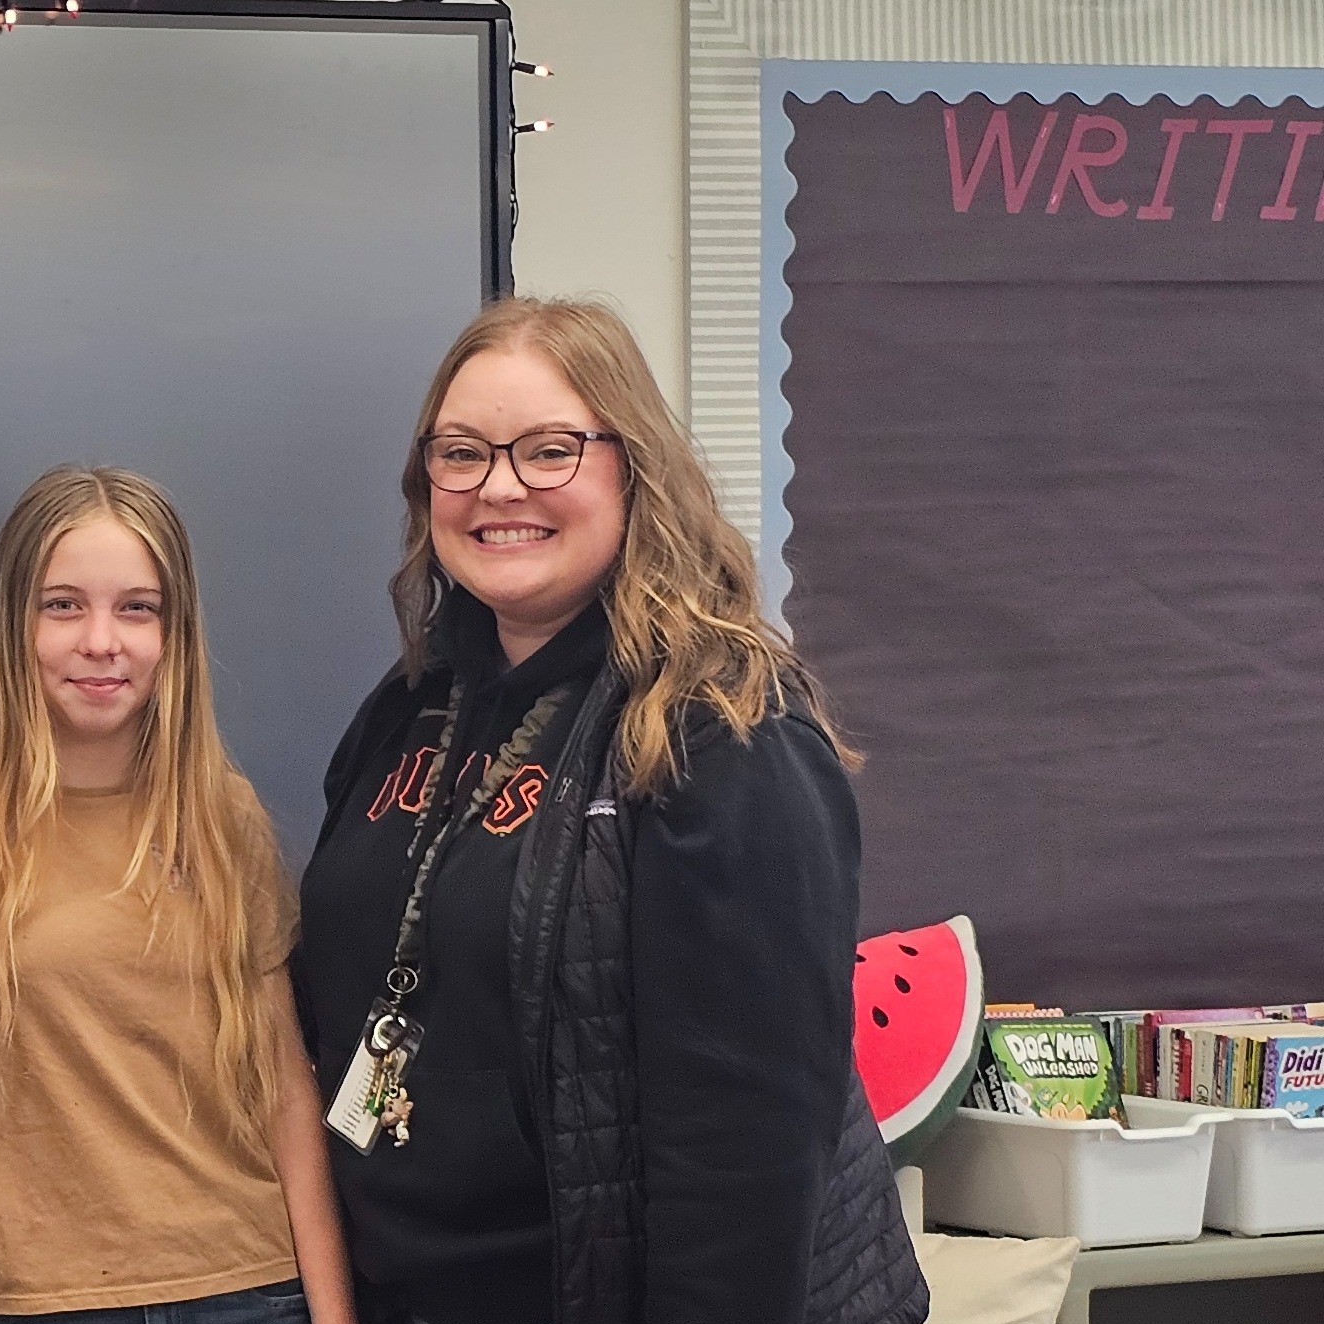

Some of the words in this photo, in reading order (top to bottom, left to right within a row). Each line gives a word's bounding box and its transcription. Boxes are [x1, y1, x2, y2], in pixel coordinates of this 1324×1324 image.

[943, 107, 1324, 221] WRITI
[1004, 1033, 1055, 1065] DOG
[1056, 1033, 1099, 1062] MAN
[1283, 1075, 1324, 1089] FUTU
